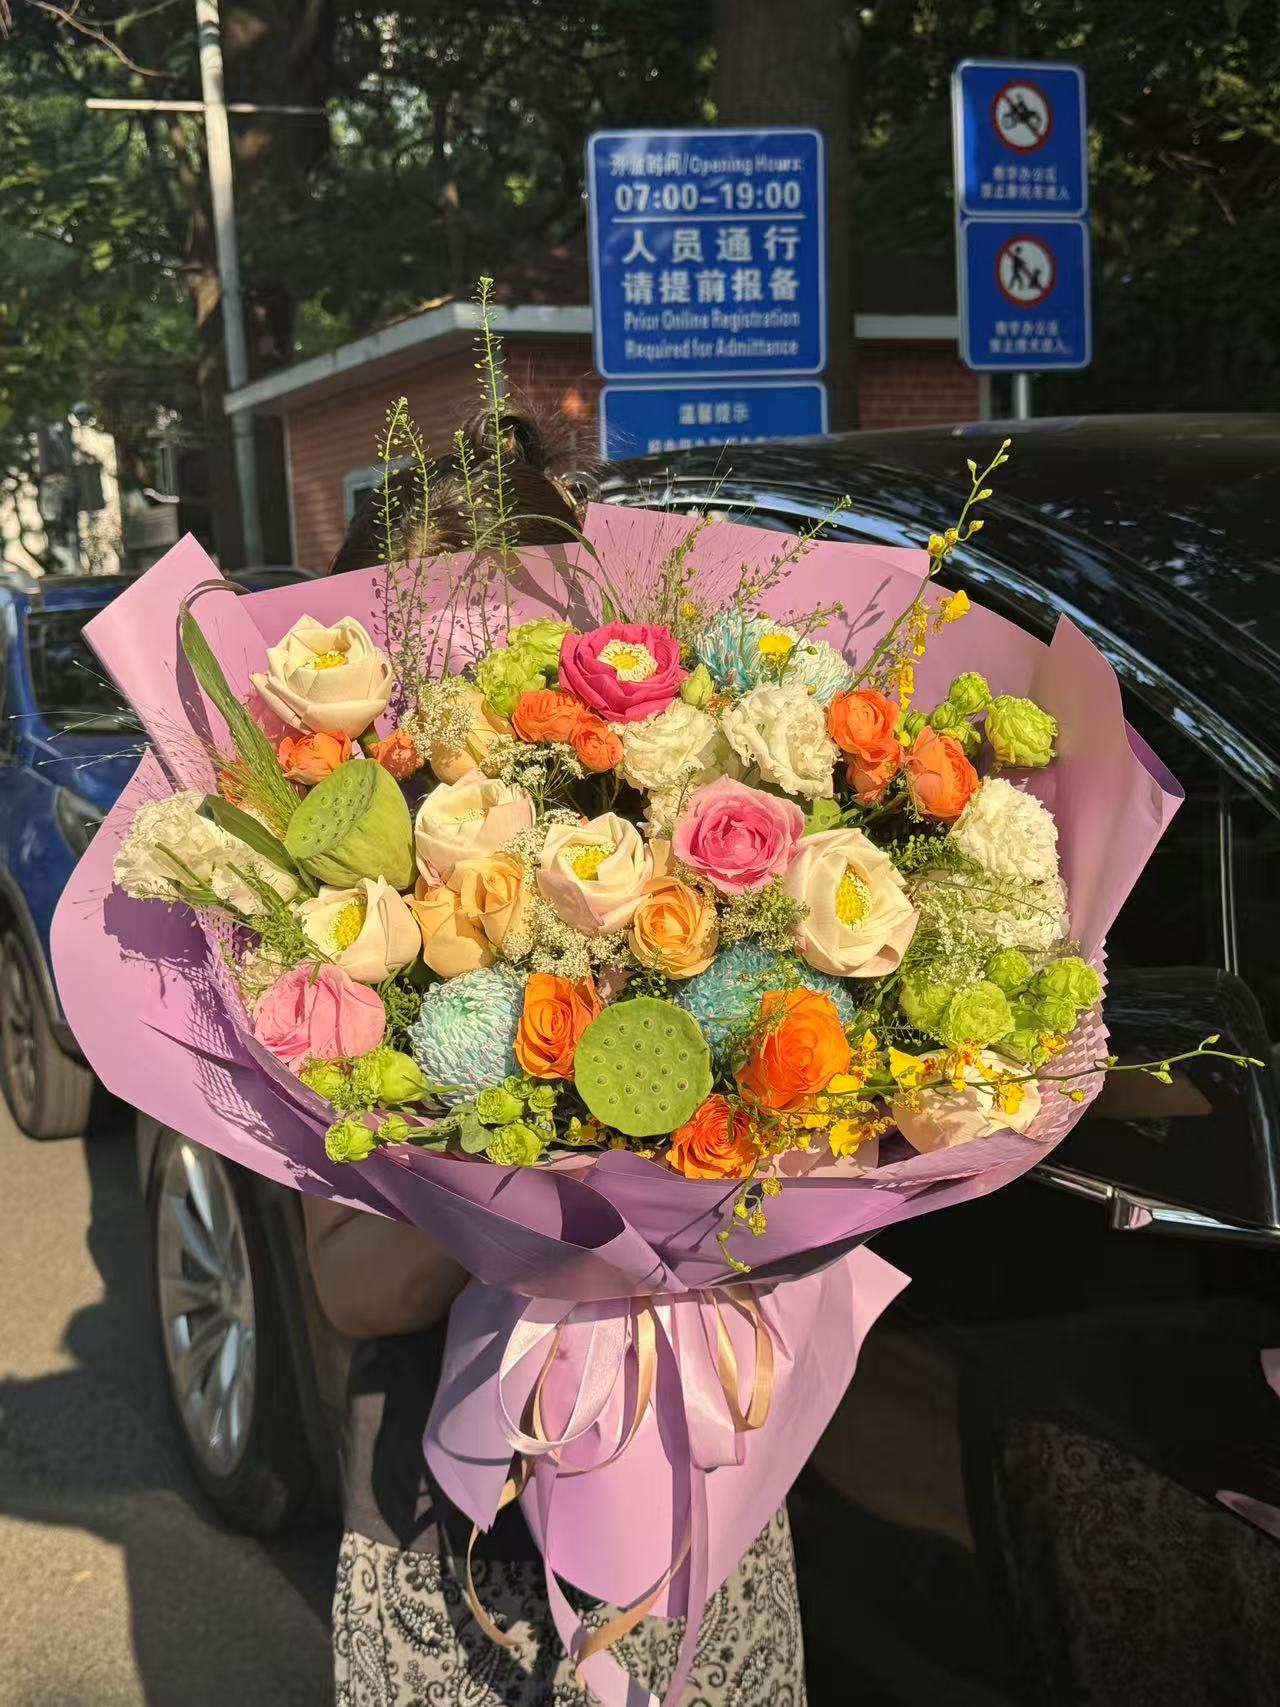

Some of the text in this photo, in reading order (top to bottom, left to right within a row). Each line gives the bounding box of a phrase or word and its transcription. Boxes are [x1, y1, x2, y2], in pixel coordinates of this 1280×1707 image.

[622, 225, 799, 264] 人员通行
[622, 267, 799, 304] 请提前报备
[624, 308, 800, 332] Prior Online Registration
[625, 337, 798, 363] Required for Admittance
